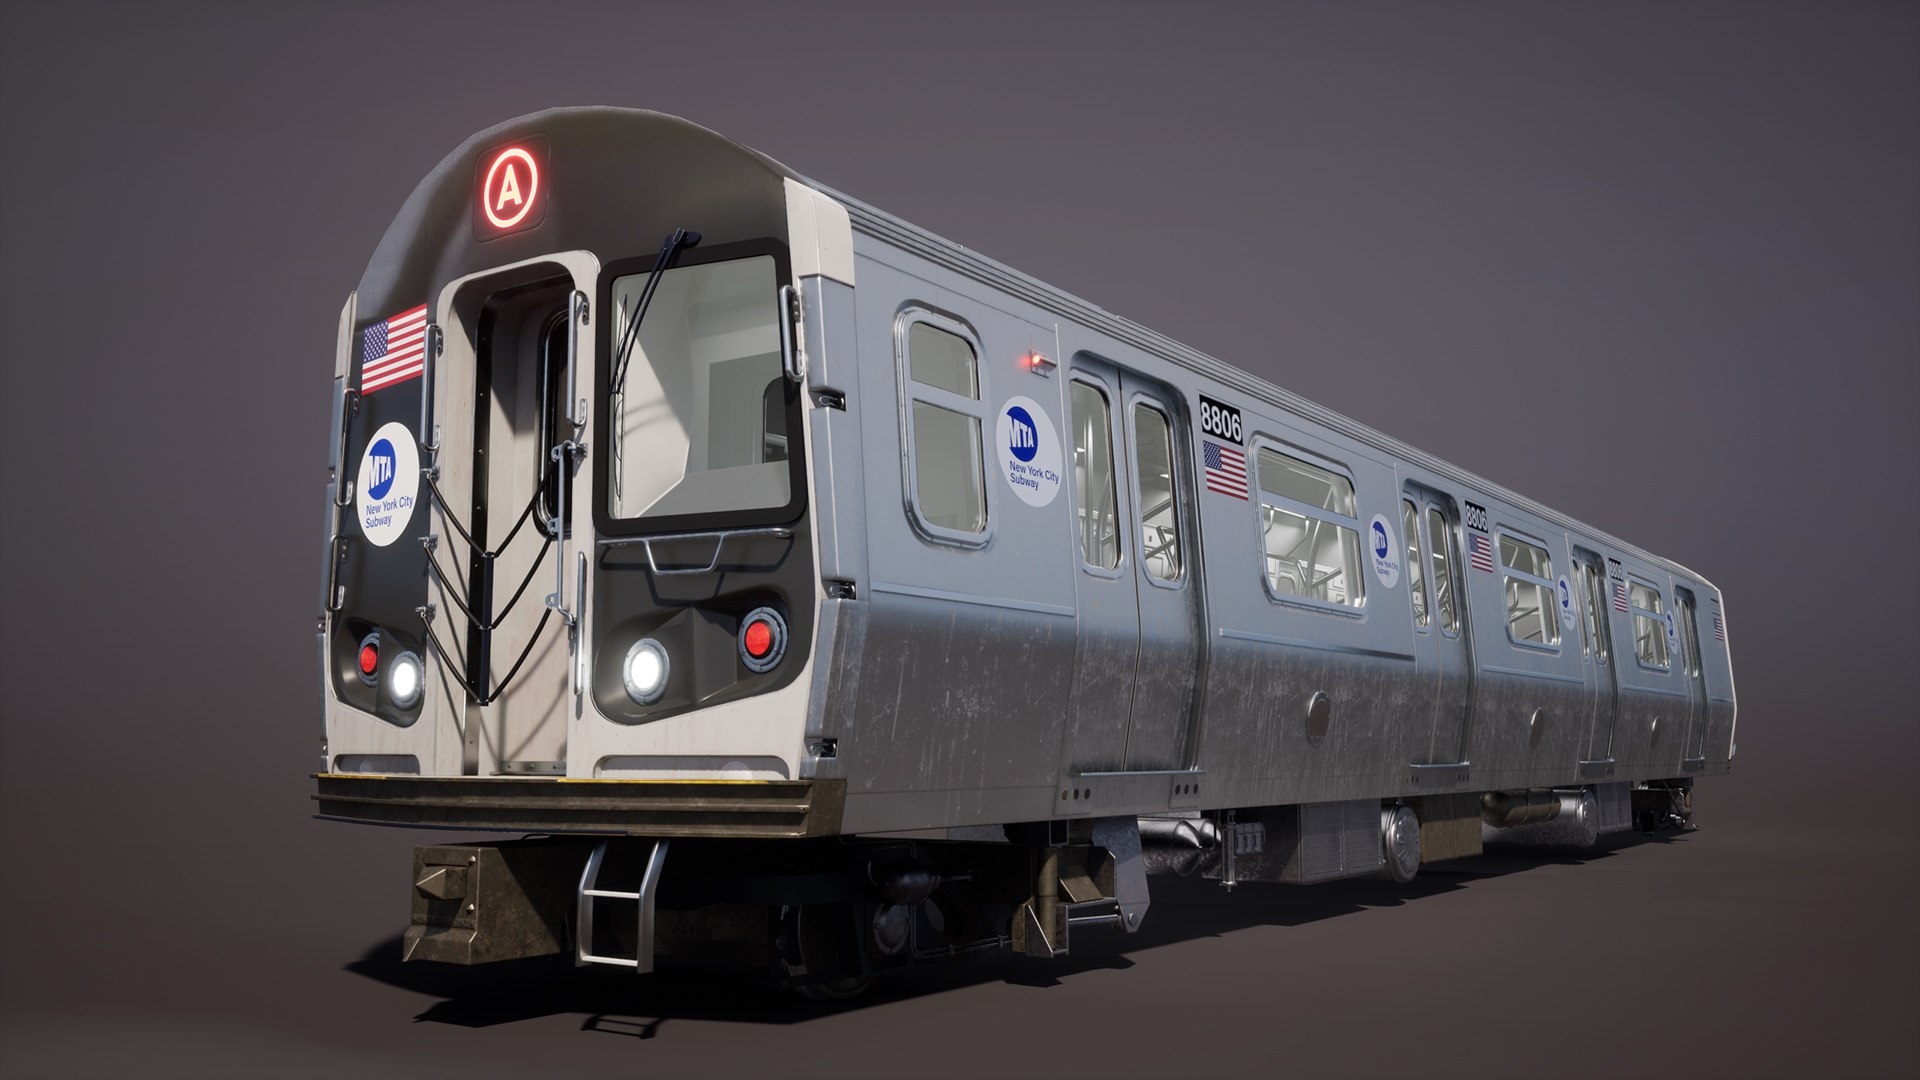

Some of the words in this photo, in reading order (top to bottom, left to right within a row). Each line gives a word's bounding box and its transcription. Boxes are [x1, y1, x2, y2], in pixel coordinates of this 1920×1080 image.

[496, 163, 523, 211] A
[1007, 415, 1035, 448] MTA
[1200, 401, 1242, 442] 8806
[367, 454, 392, 492] MTA
[1009, 460, 1027, 474] New
[1027, 465, 1045, 478] York
[1045, 470, 1060, 485] City
[1010, 472, 1039, 491] Subway
[366, 504, 382, 516] New
[382, 500, 398, 512] York
[399, 495, 414, 509] City
[1465, 504, 1489, 531] 8806
[365, 514, 392, 529] Subway
